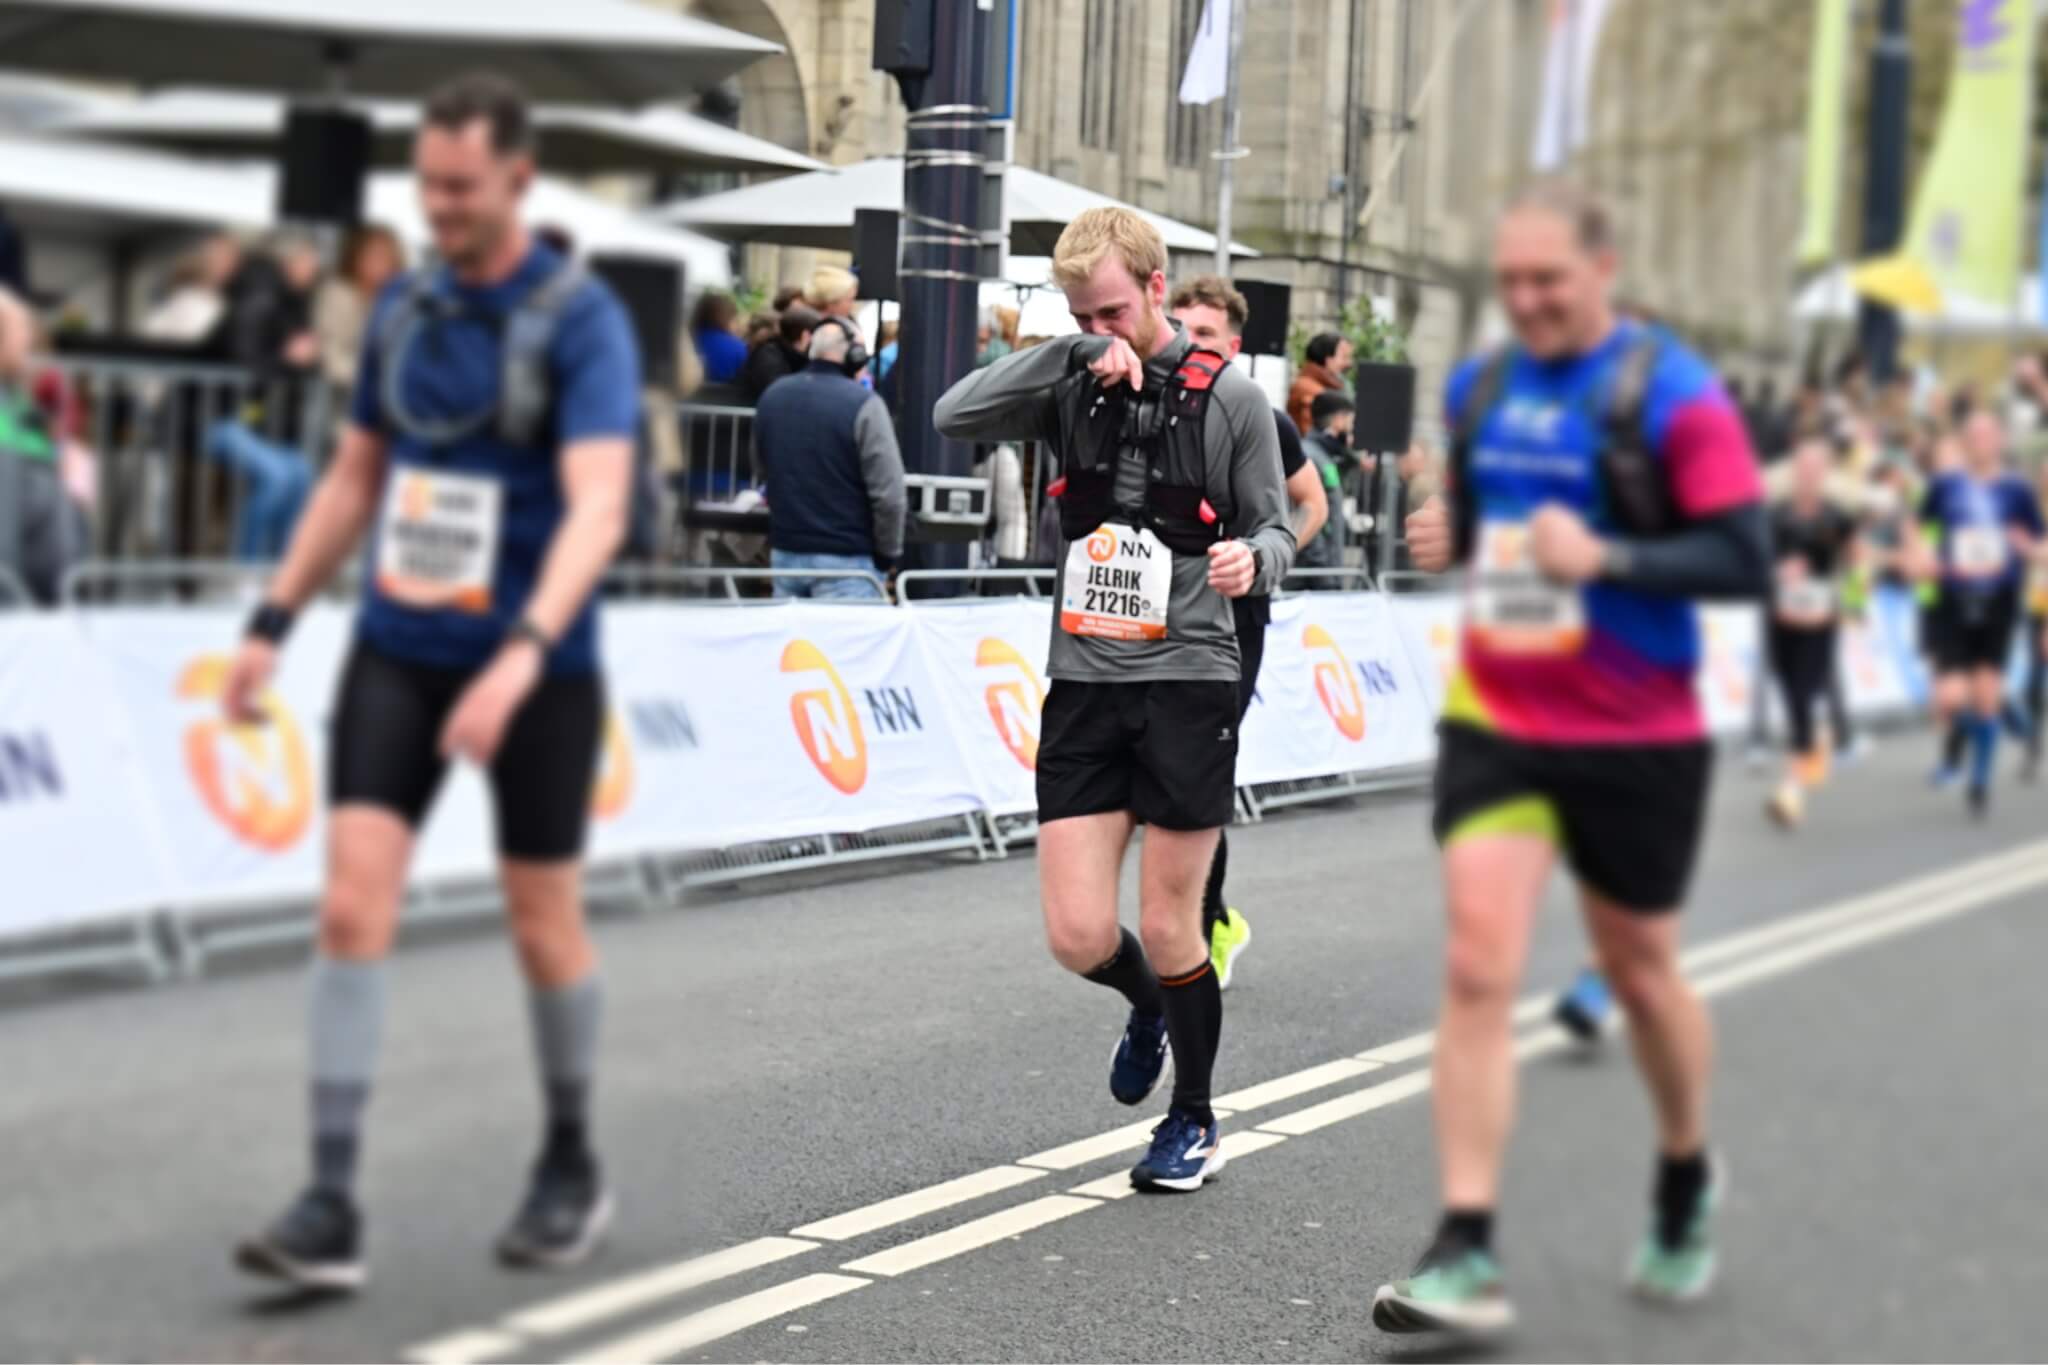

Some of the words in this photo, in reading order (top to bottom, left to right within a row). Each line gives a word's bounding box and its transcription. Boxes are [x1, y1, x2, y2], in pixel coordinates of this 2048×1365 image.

[1121, 540, 1152, 559] NN
[1087, 565, 1142, 591] JELRIK
[1085, 588, 1140, 617] 21216
[864, 685, 924, 734] NN
